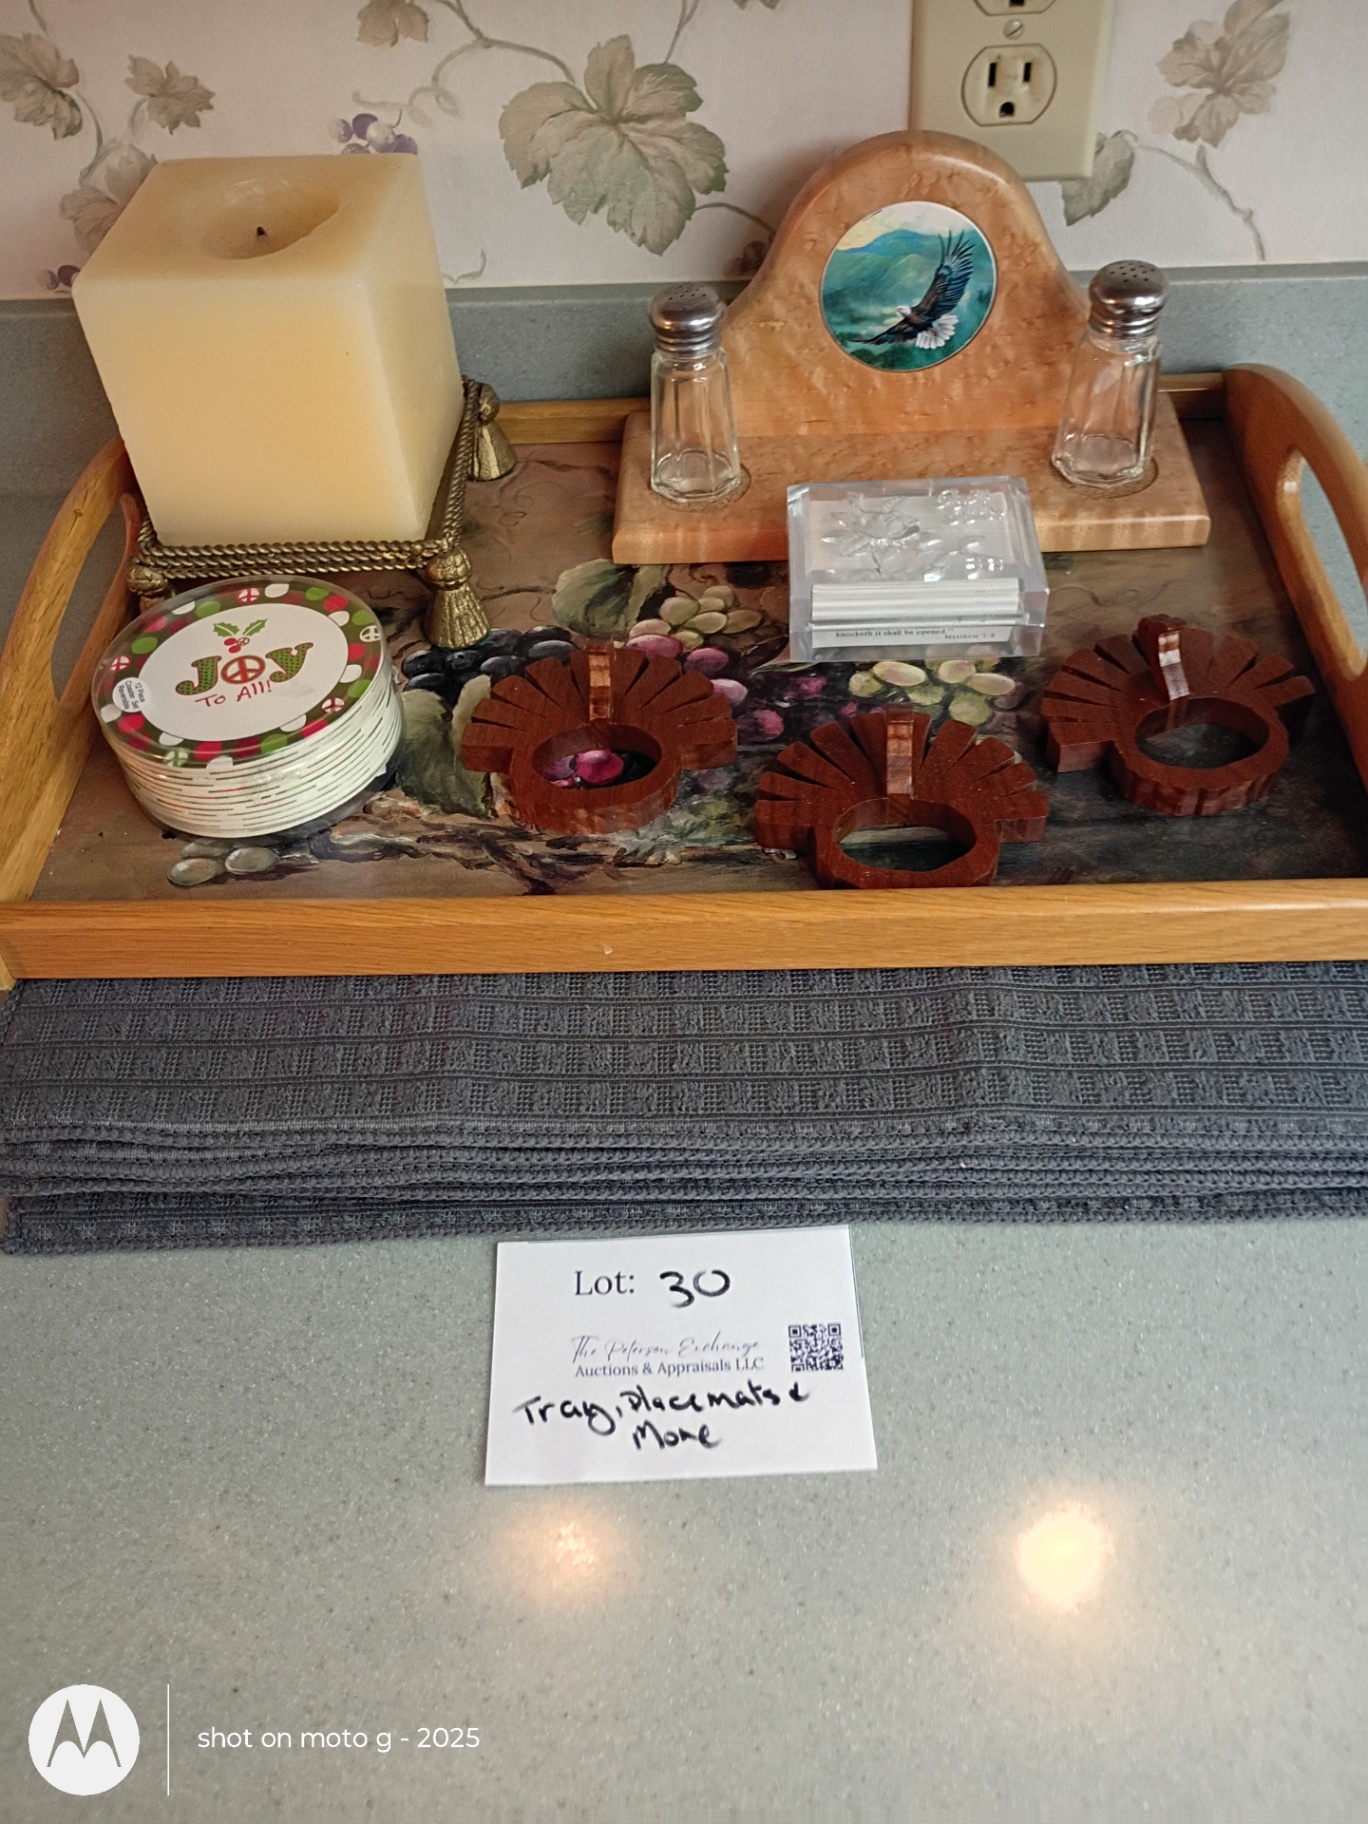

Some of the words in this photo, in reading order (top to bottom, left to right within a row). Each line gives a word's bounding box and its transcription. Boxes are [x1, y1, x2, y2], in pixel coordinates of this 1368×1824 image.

[883, 629, 902, 637] shall
[904, 628, 914, 636] be
[175, 642, 314, 696] JOY
[194, 693, 226, 707] To
[236, 679, 273, 703] All!
[574, 1270, 634, 1296] Lot:
[659, 1269, 731, 1309] 30
[571, 1334, 601, 1363] The
[678, 1330, 760, 1358] Exchange
[575, 1364, 639, 1378] Auctions
[642, 1362, 654, 1375] &
[657, 1358, 732, 1378] Appraisals
[736, 1356, 765, 1371] LLC
[632, 1420, 723, 1451] More
